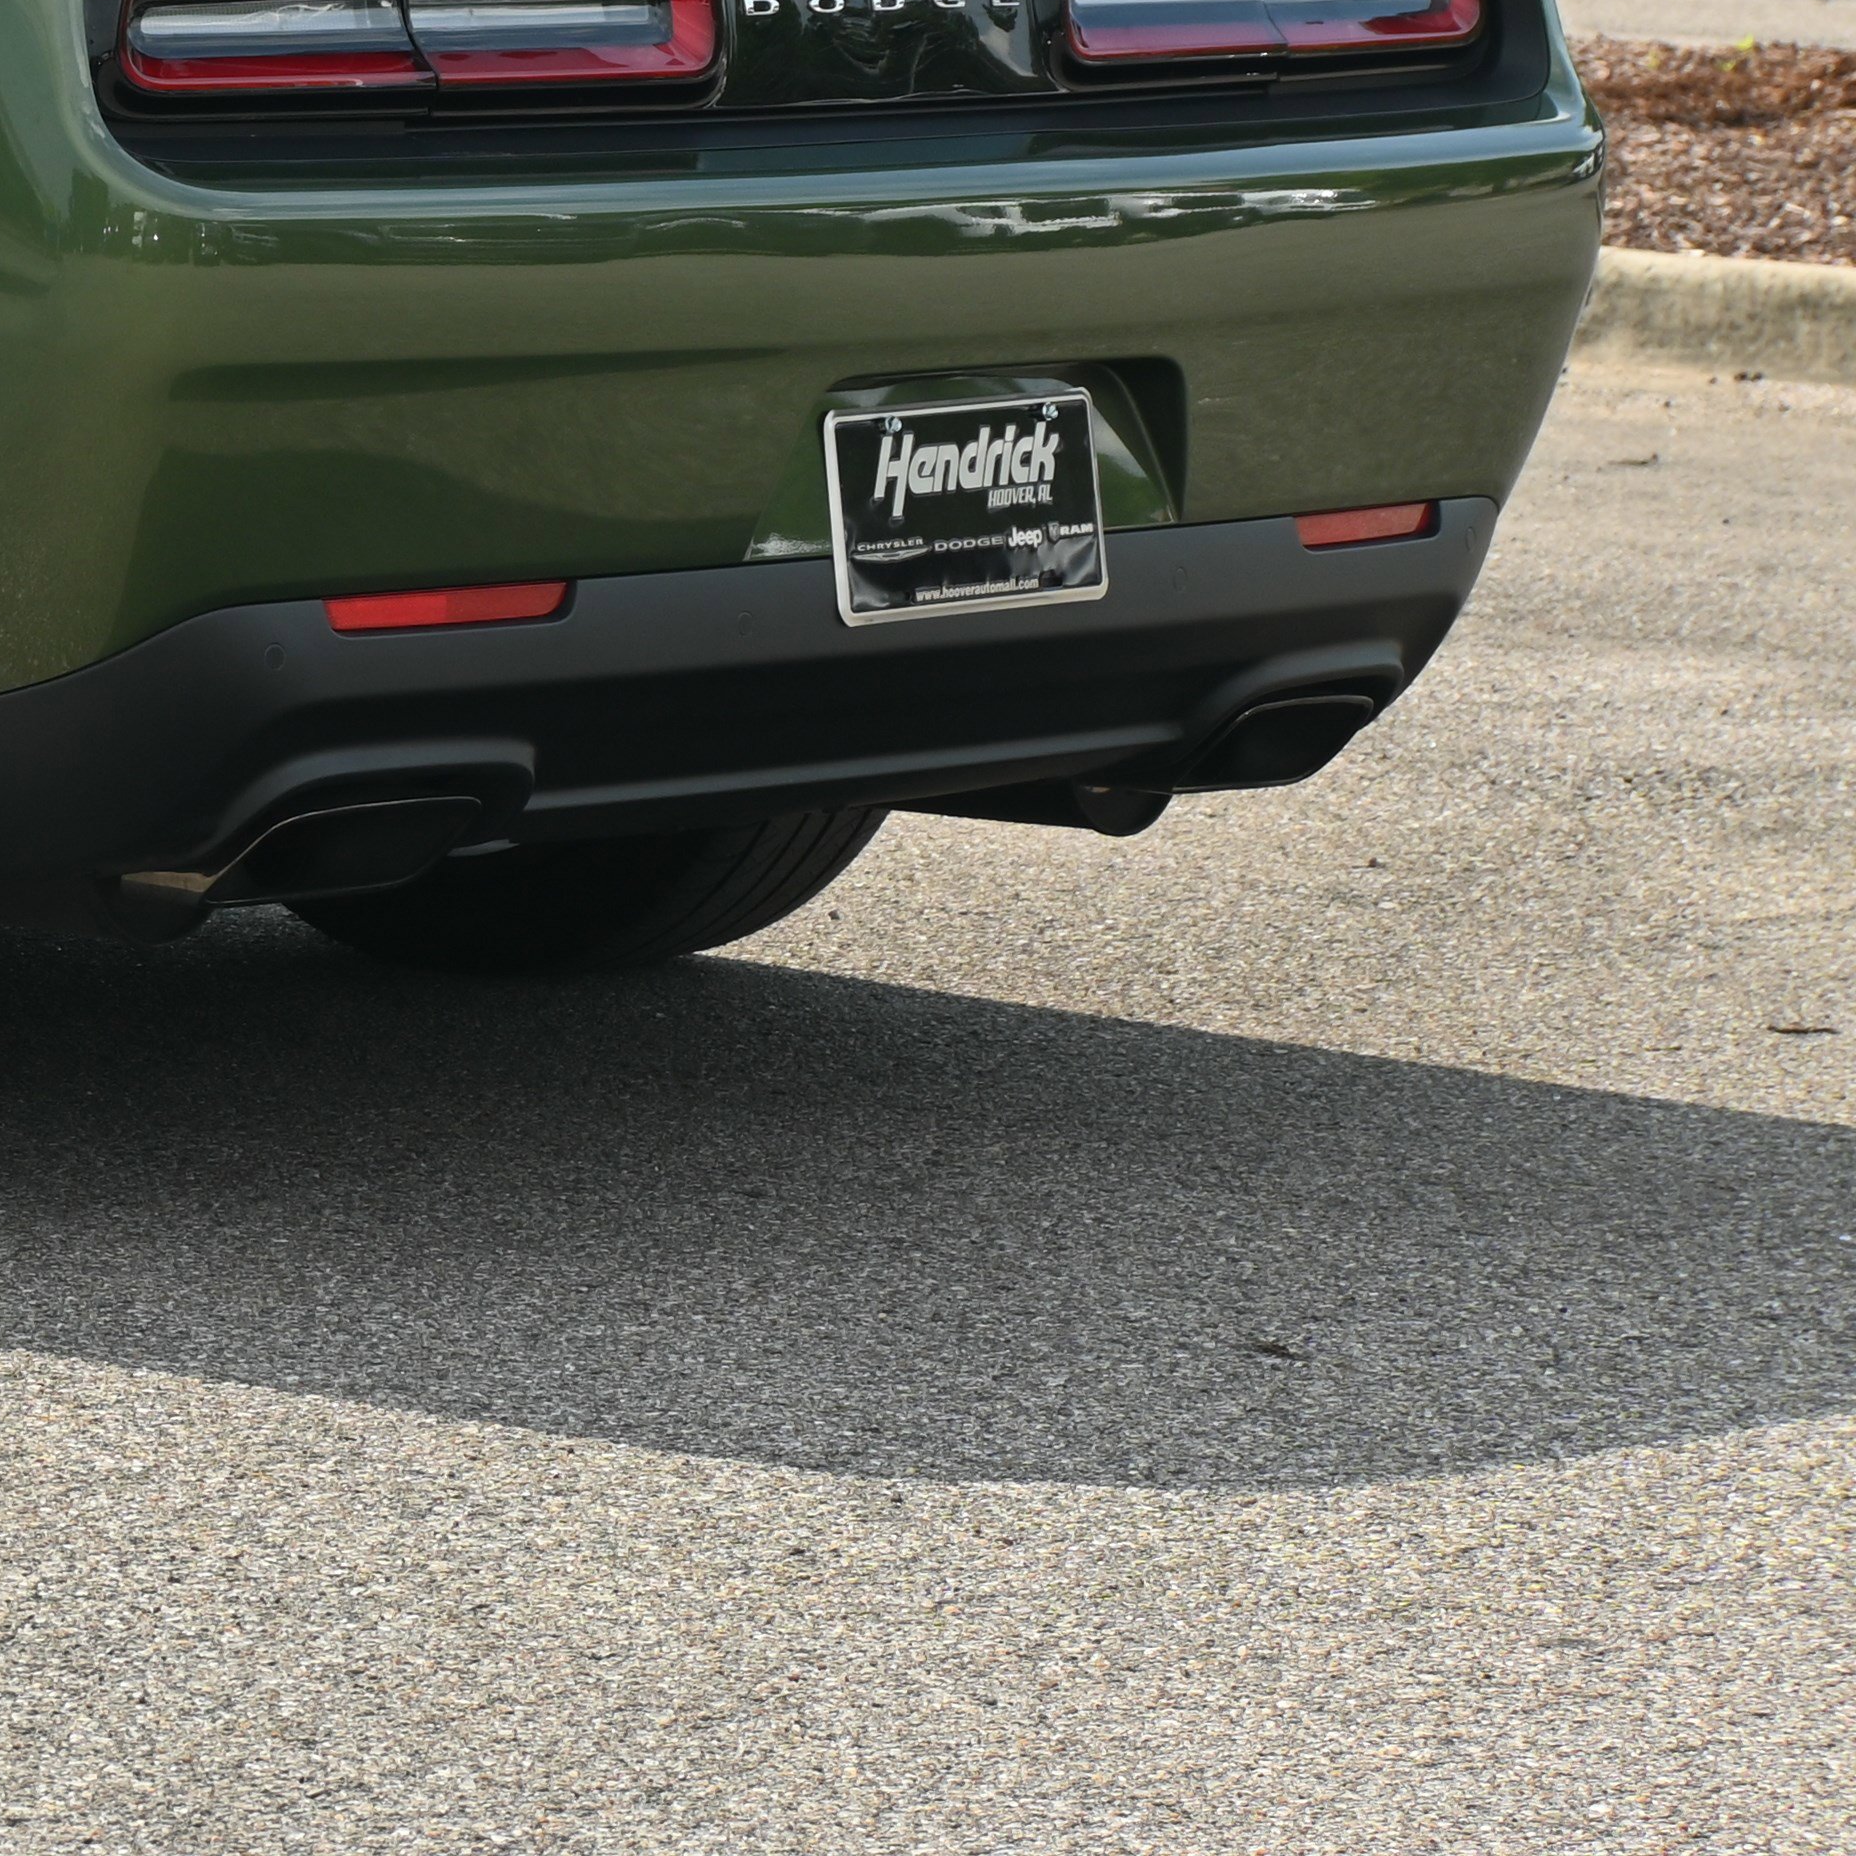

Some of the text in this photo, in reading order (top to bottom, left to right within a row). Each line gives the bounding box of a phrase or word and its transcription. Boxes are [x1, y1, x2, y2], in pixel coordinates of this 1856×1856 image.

[872, 421, 1060, 519] Hendrick
[988, 483, 1054, 508] HOOVER, AL
[857, 523, 1094, 552] CHRYSLER DODGE Jeep RAM
[915, 577, 1040, 603] www.hooverautomall.com
